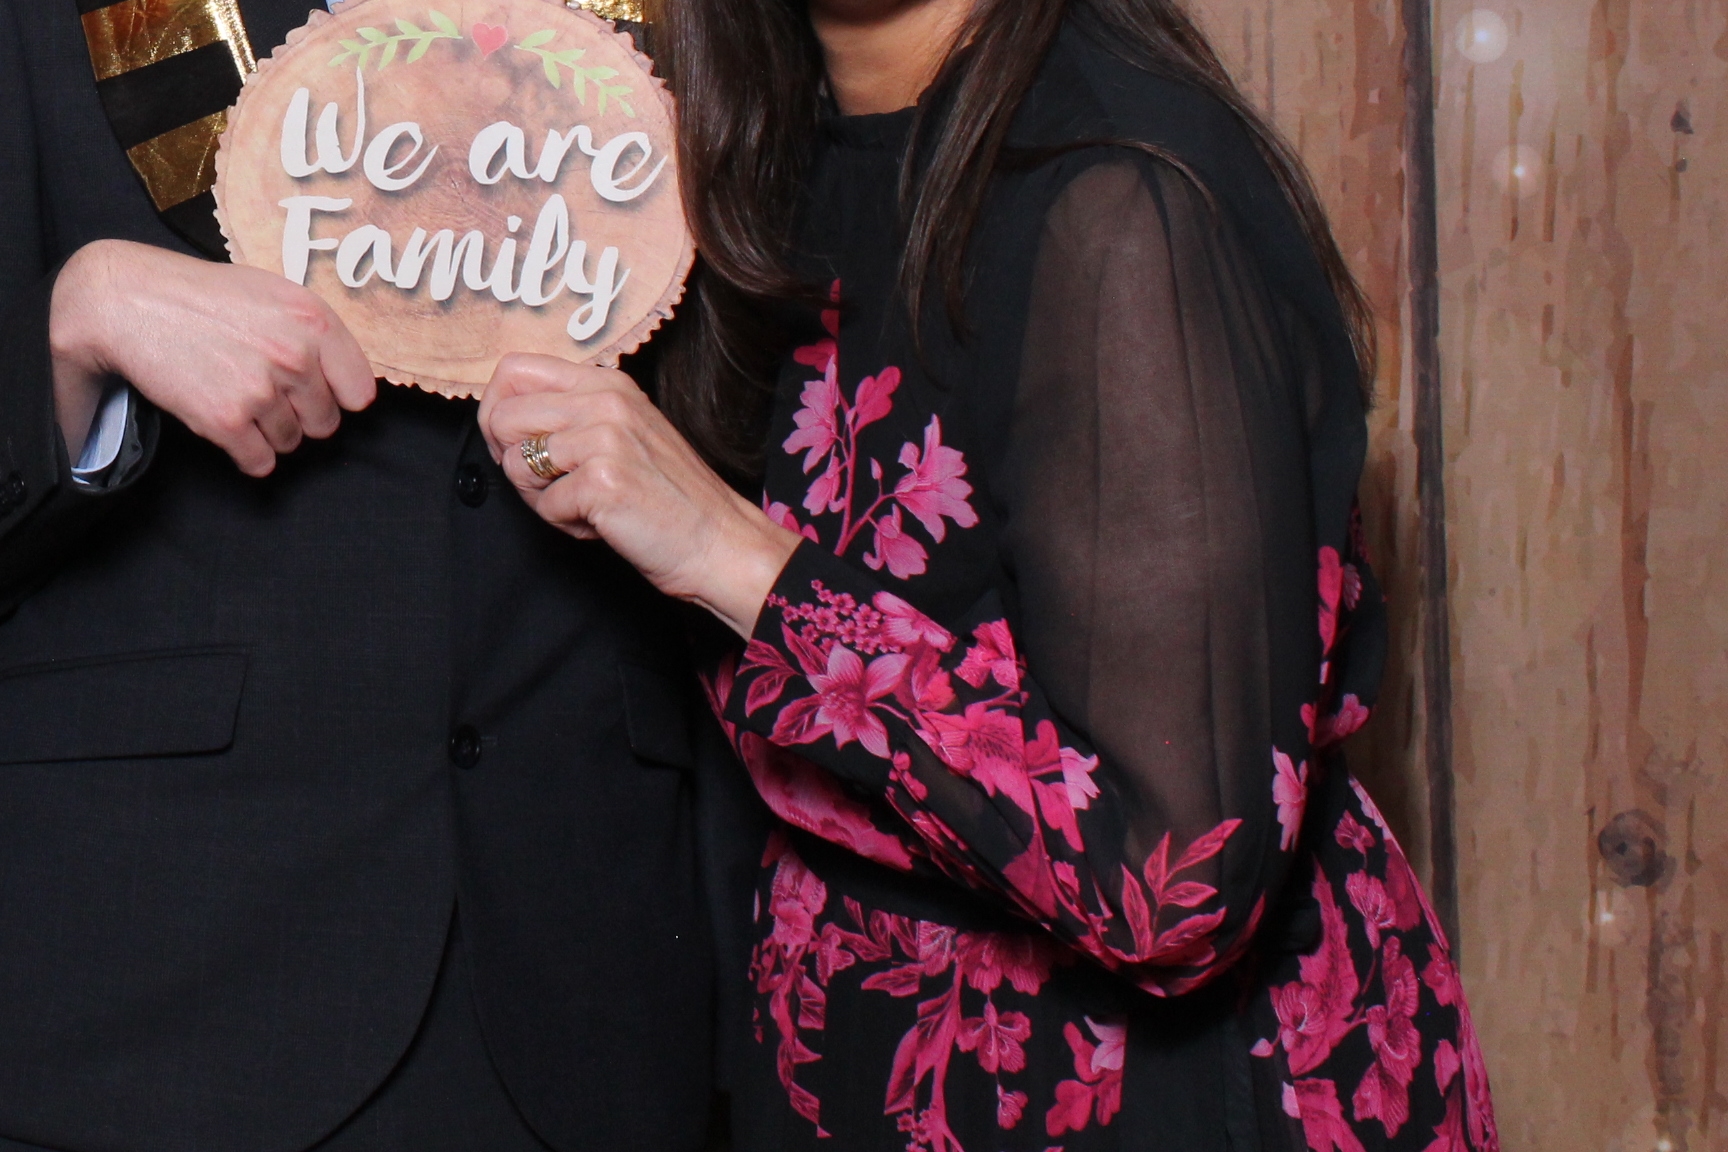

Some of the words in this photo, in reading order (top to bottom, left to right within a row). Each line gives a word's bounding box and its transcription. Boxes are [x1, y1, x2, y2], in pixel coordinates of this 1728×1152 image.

[280, 66, 439, 191] We
[469, 121, 668, 202] are
[278, 194, 631, 341] Family
